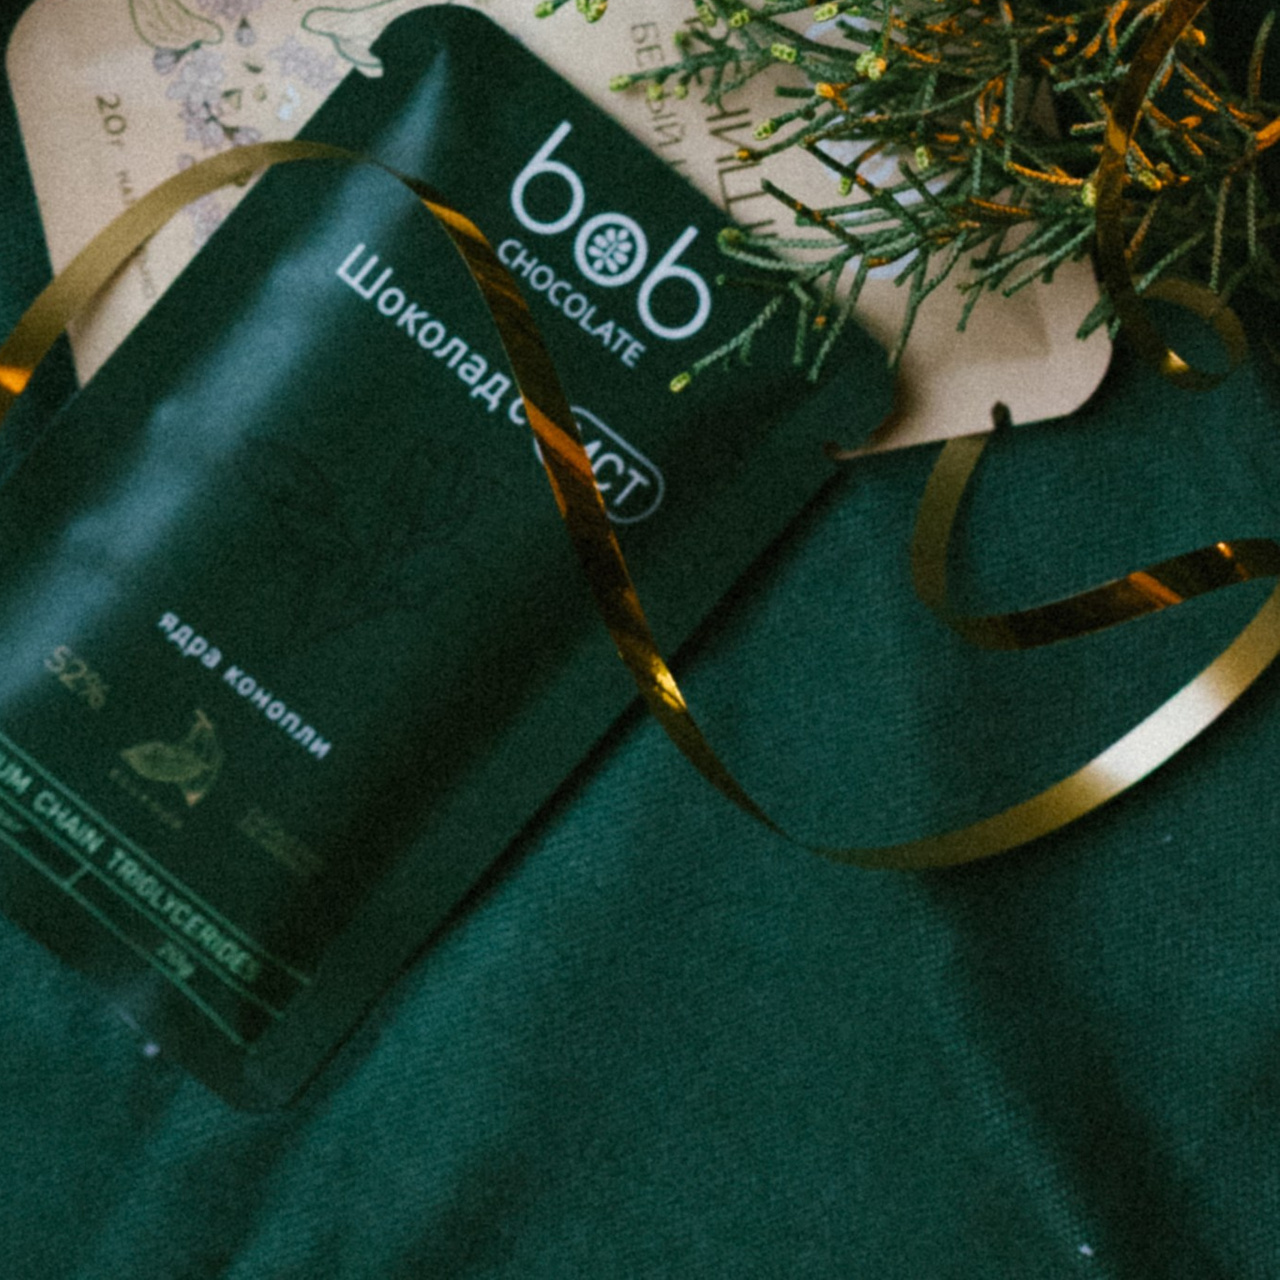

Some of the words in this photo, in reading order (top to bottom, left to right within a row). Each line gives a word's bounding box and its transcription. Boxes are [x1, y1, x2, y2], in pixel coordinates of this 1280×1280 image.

[496, 238, 648, 370] CHOCOLATE
[510, 120, 712, 340] bob
[335, 242, 512, 413] Шоколад
[157, 610, 223, 670] ядра
[222, 664, 333, 760] конопли
[32, 790, 106, 855] CHAIN
